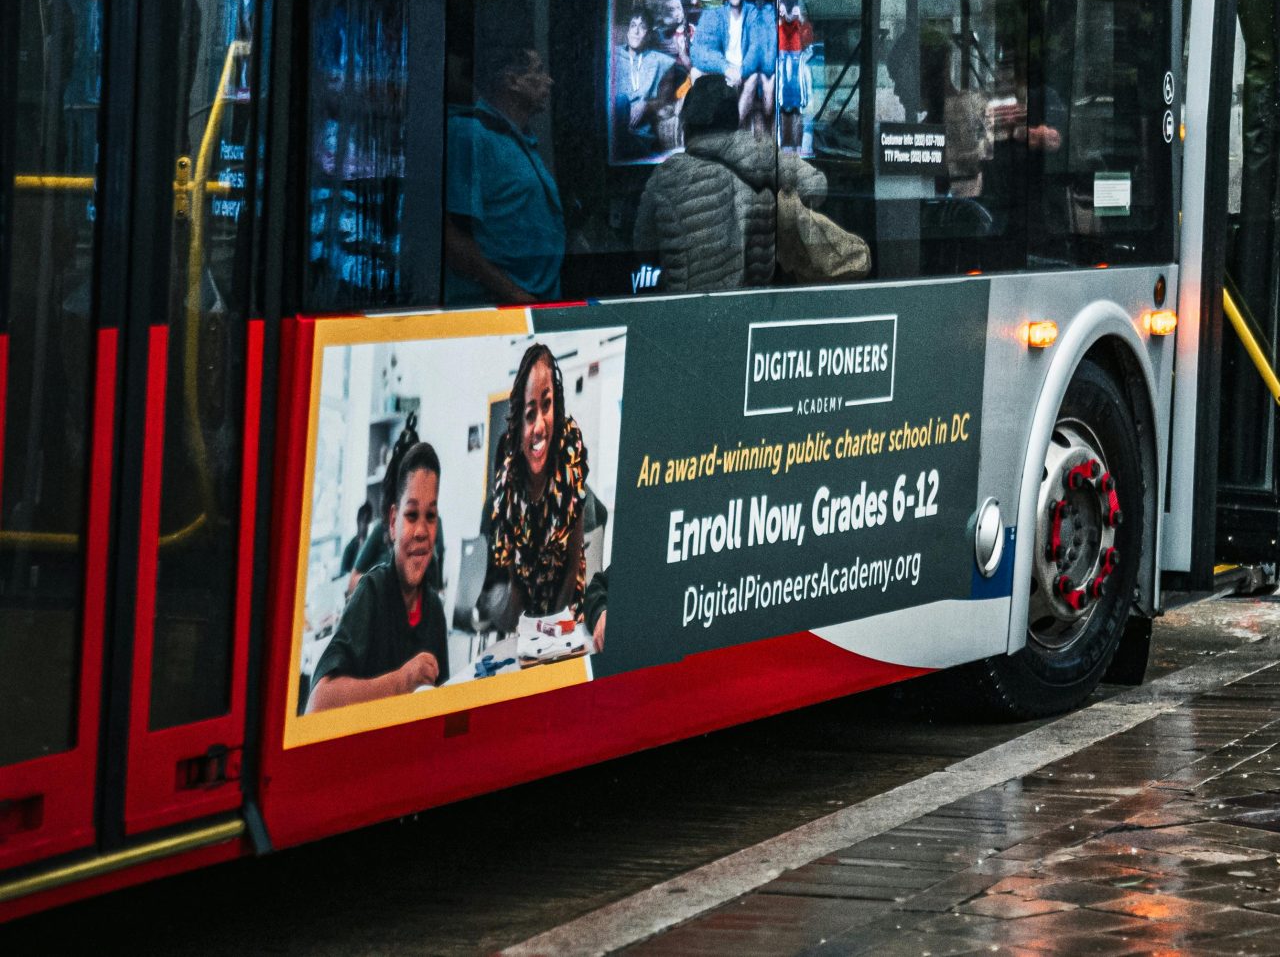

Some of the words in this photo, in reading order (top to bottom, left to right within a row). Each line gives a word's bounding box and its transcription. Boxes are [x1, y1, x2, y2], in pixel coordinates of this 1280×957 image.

[753, 349, 813, 383] DIGITAL
[818, 344, 889, 377] PIONEERS
[796, 396, 844, 416] ACADEMY
[637, 454, 661, 488] An
[665, 438, 783, 486] award-winning
[785, 430, 831, 472] public
[834, 427, 885, 460] charter
[888, 418, 932, 452] school
[935, 420, 948, 445] in
[951, 412, 971, 443] DC
[666, 496, 742, 565] Enroll
[747, 495, 806, 548] Now,
[811, 479, 888, 539] Grades
[892, 469, 939, 522] 6-12
[682, 551, 923, 629] DigitalPioneersAcademy.org
